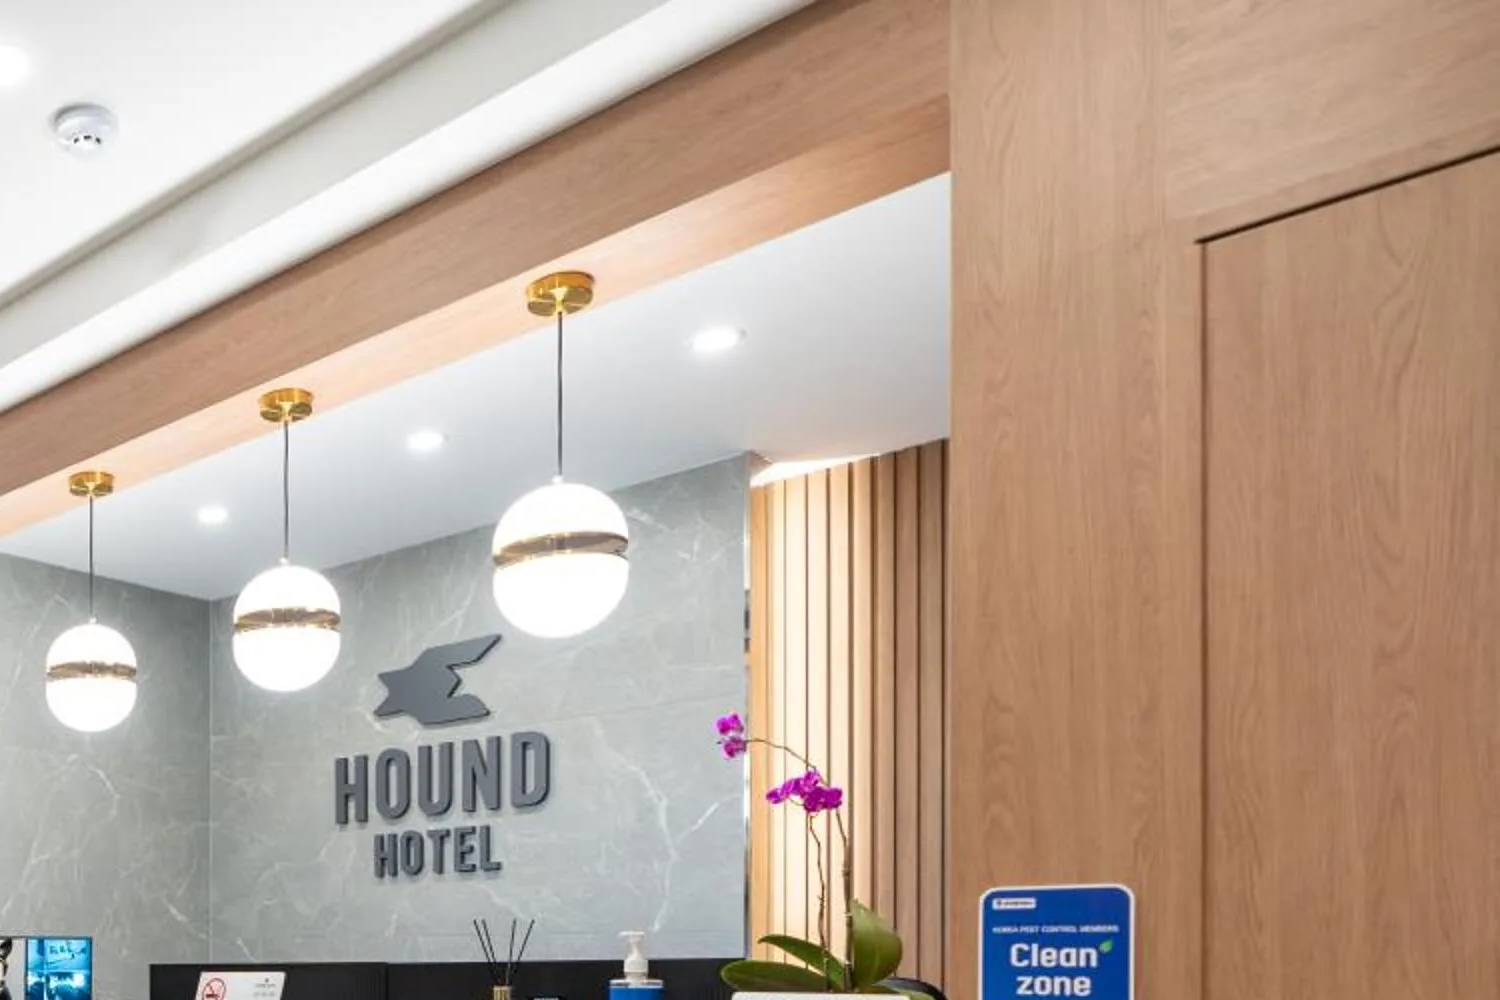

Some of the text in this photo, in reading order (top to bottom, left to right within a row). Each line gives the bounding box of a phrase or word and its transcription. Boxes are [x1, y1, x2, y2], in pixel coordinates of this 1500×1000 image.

[335, 731, 551, 825] HOUND
[374, 825, 502, 879] HOTEL
[1010, 943, 1098, 968] Clean
[1016, 975, 1092, 996] zone
